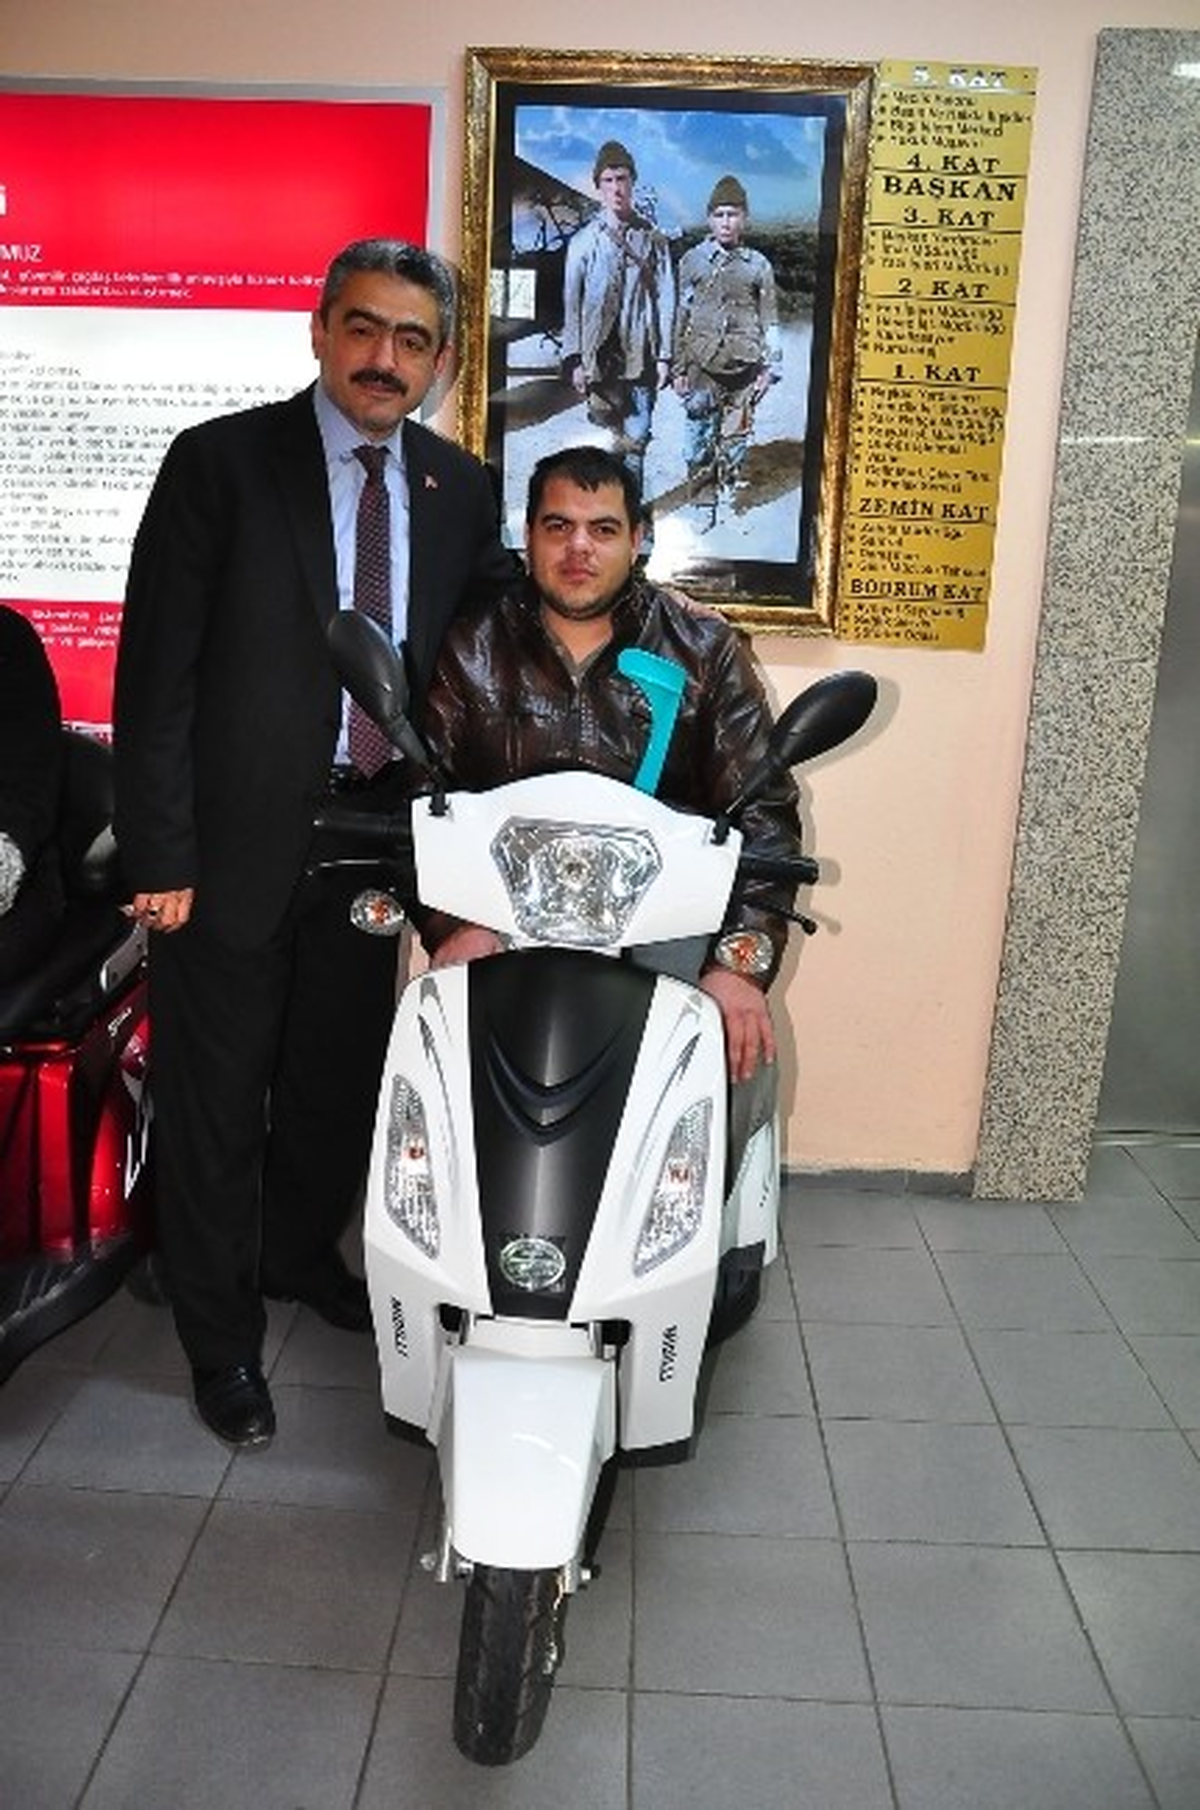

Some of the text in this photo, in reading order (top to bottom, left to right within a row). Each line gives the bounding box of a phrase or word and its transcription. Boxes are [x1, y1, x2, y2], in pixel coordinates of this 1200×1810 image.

[949, 67, 1006, 89] KAT
[907, 153, 1000, 174] 4. KAT
[882, 175, 1017, 201] BAŞKAN
[903, 206, 995, 227] 3. KAT
[898, 278, 989, 299] 2. KAT
[893, 363, 981, 383] 1. KAT
[859, 498, 989, 519] ZEMİN KAT
[850, 578, 984, 600] BODRUM KAT
